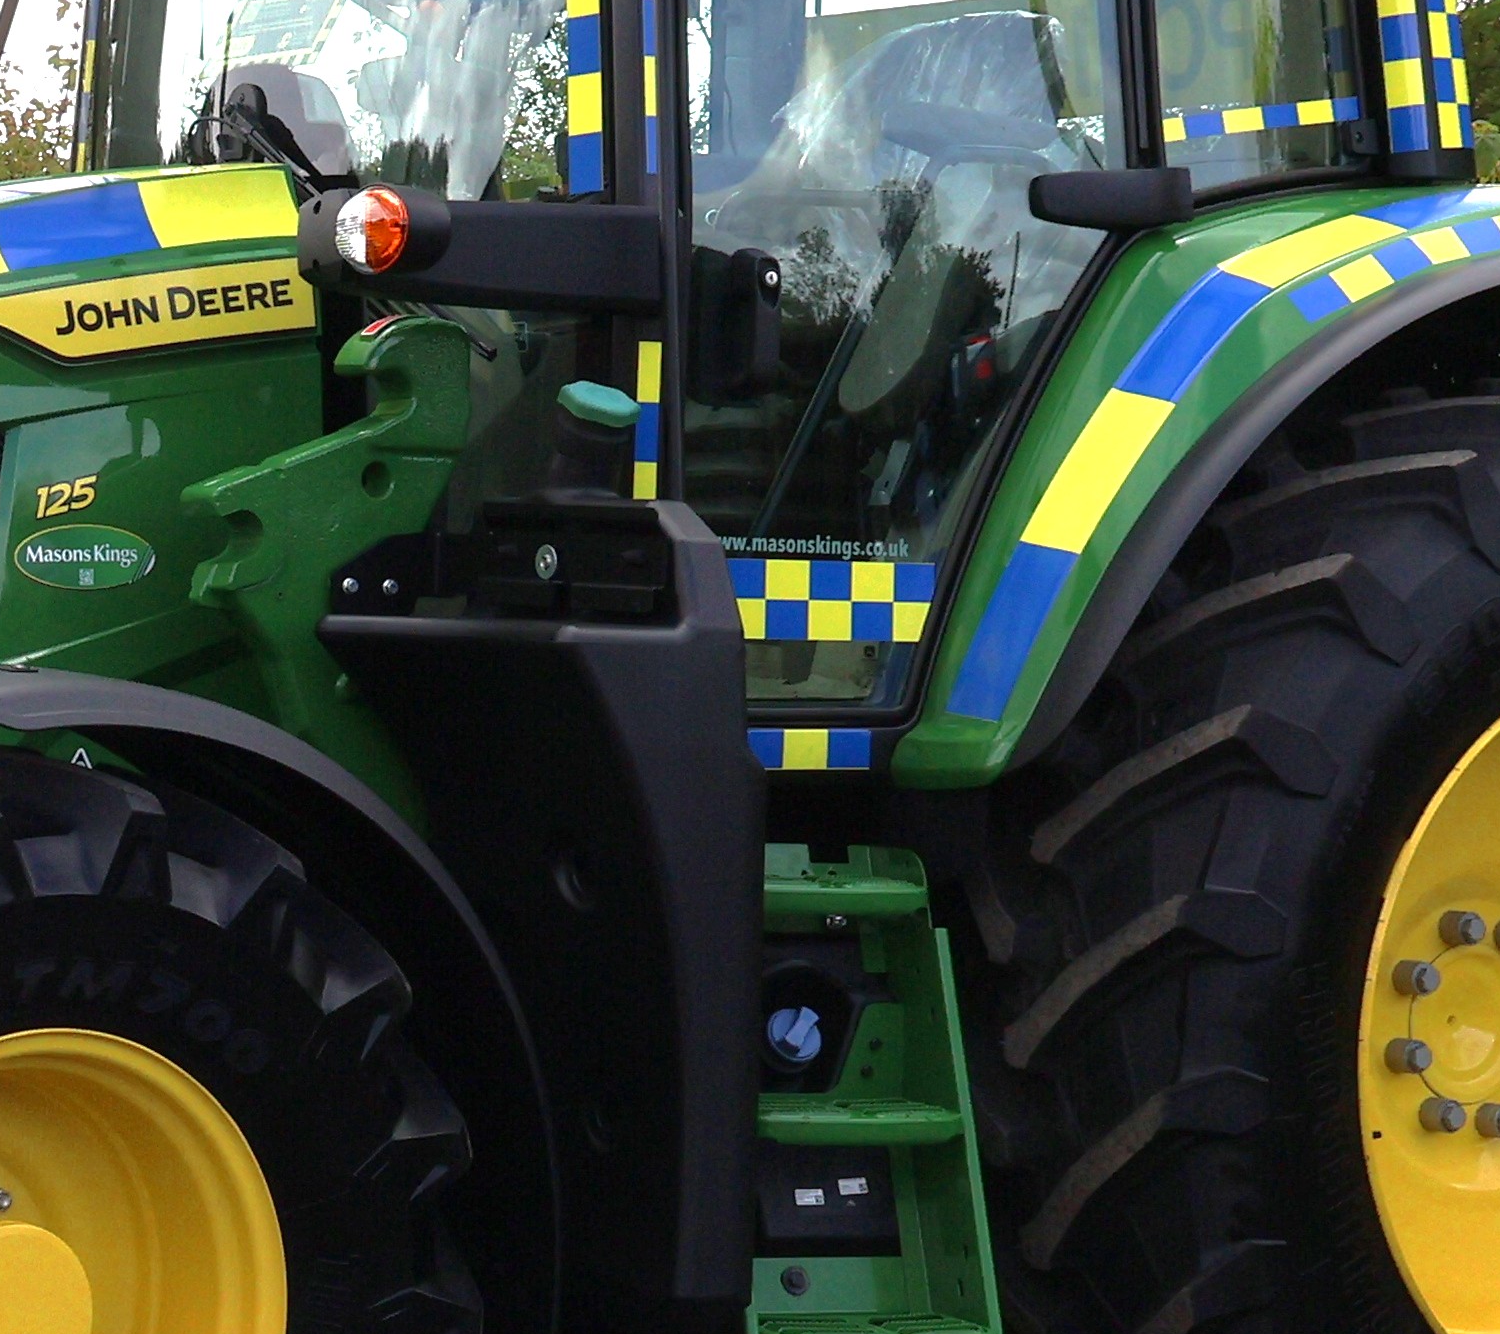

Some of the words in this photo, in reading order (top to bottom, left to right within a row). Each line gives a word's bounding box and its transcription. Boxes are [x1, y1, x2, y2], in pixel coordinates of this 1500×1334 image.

[55, 296, 160, 336] JOHN
[169, 278, 294, 321] DEERE
[35, 474, 98, 520] 125
[25, 544, 94, 564] Masons
[94, 543, 138, 568] Kings
[719, 534, 909, 560] ww.masonskings.co.uk
